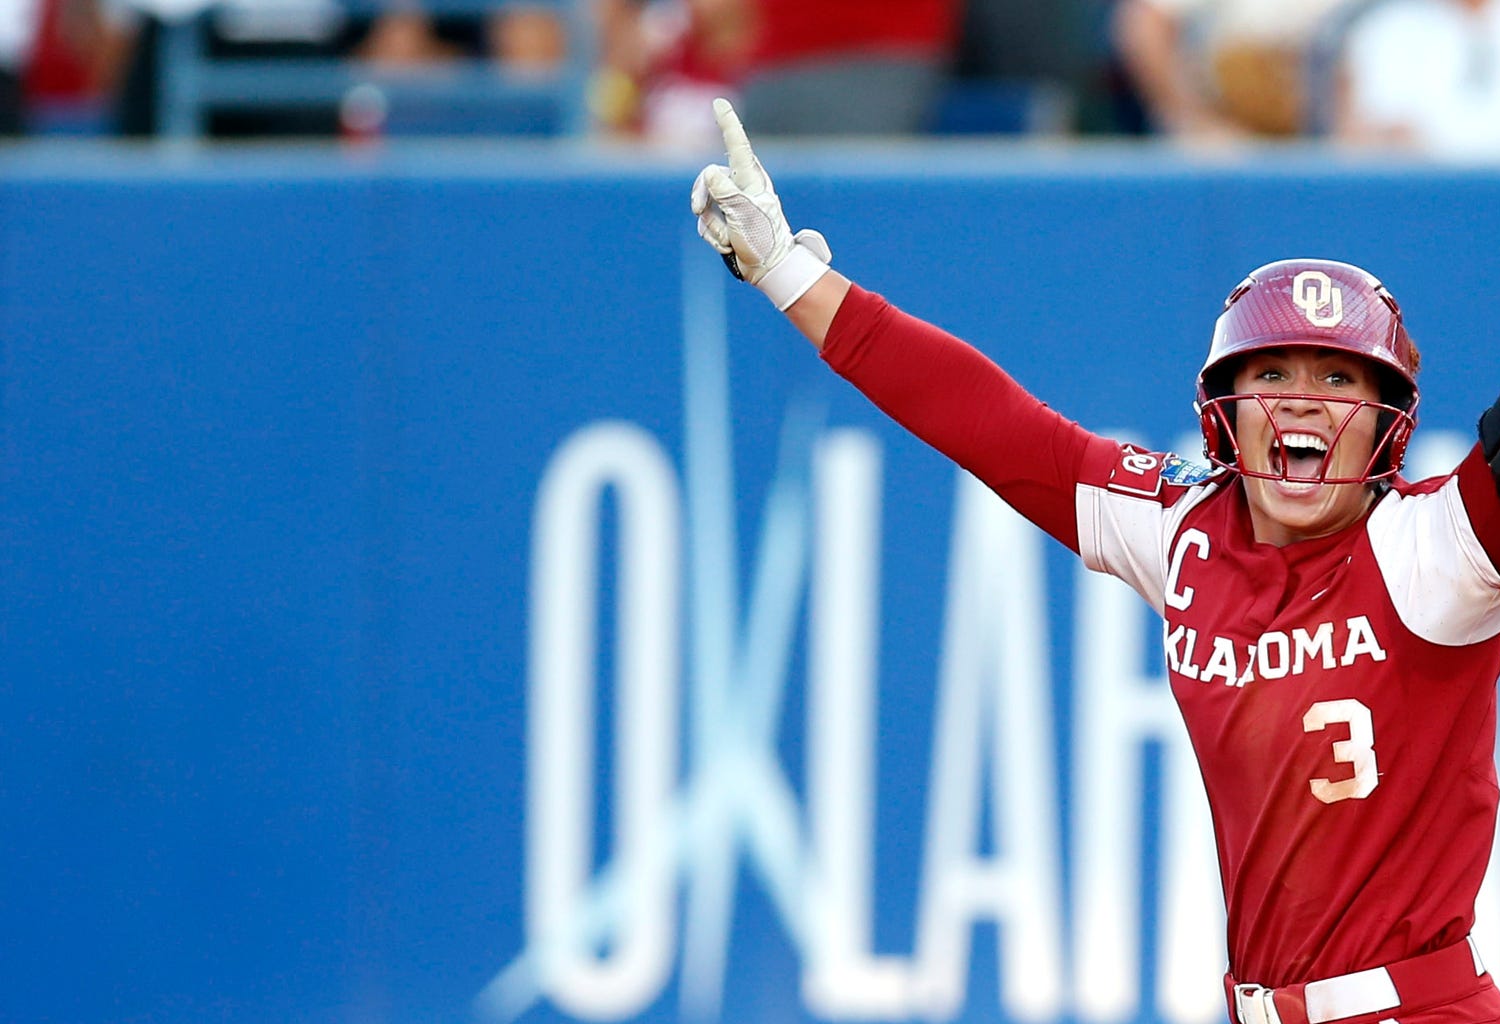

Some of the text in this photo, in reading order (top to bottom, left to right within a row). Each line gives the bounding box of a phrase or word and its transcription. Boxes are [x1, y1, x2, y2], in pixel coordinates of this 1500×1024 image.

[1292, 270, 1343, 327] OU
[1165, 527, 1210, 611] C
[1163, 615, 1387, 688] KLAOMA
[1302, 698, 1379, 804] 3
